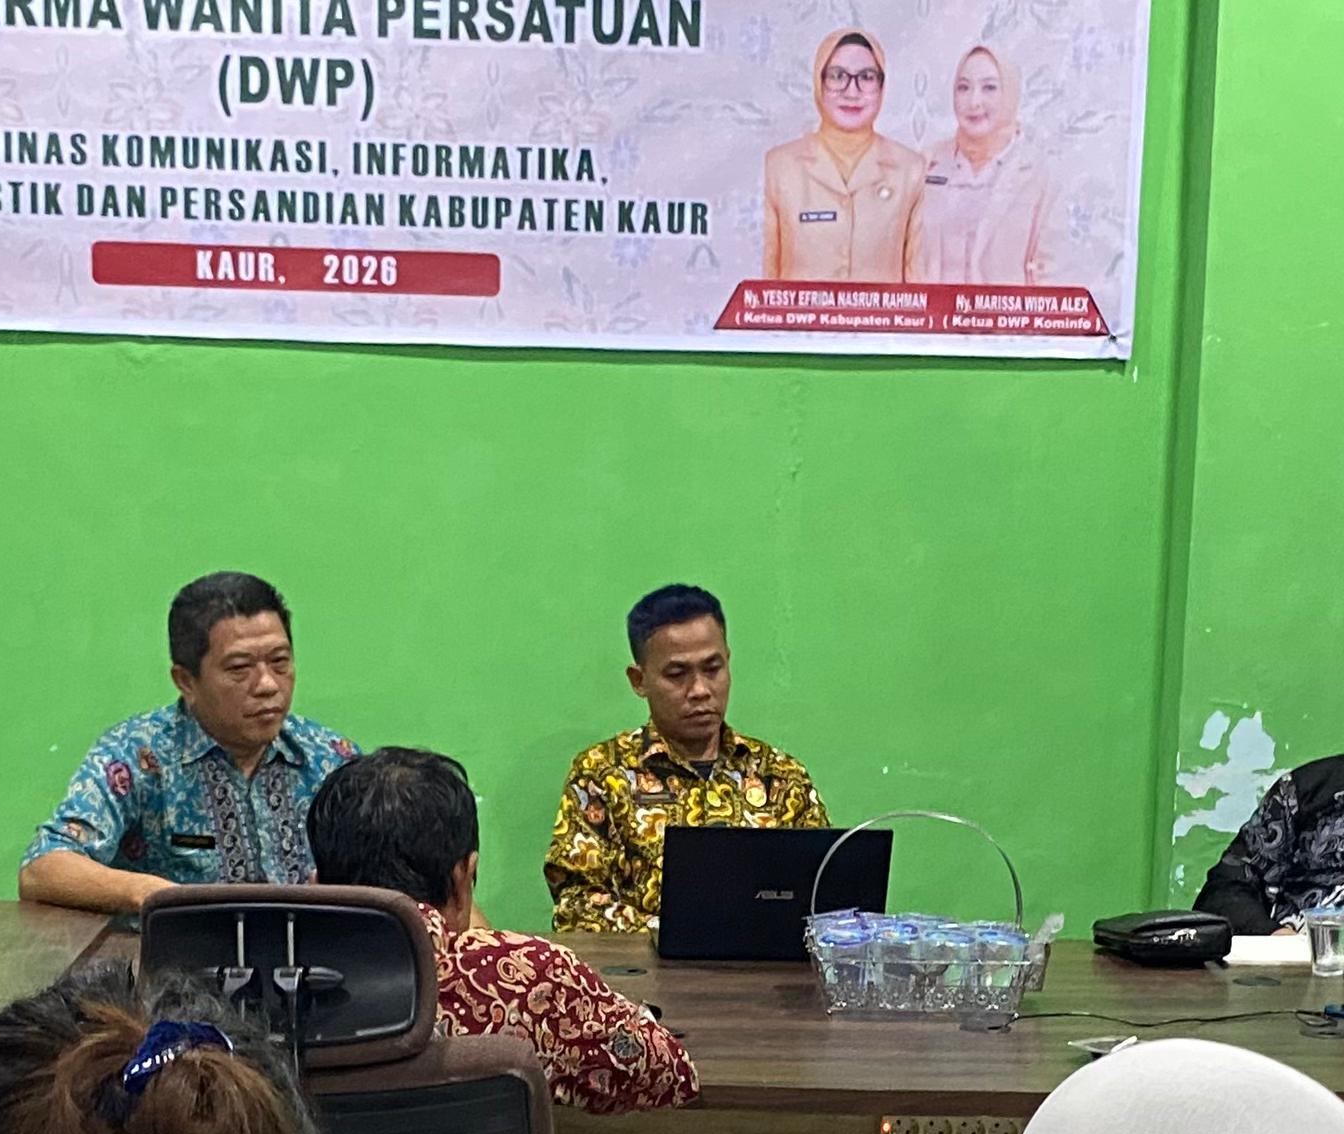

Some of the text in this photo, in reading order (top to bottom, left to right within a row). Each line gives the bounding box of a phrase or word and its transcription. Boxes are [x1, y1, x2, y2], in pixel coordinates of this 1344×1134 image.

[143, 0, 356, 37] WANITA
[378, 0, 701, 47] PERSATUAN
[219, 54, 374, 121] (DWP)
[102, 133, 339, 178] KOMUNIKASI,
[353, 142, 609, 185] INFORMATIKA,
[77, 184, 146, 218] DAN
[161, 186, 385, 226] PERSANDIAN
[398, 194, 604, 233] KABUPATEN
[617, 200, 709, 235] KAUR
[195, 250, 399, 286] KAUR, 2026
[762, 290, 796, 306] YESSY
[882, 292, 927, 309] RAHMAN
[975, 295, 1022, 311] MARISSA
[1024, 295, 1058, 312] WIDYA
[1061, 296, 1088, 312] ALEX
[744, 312, 783, 324] Ketua
[786, 313, 816, 324] DWP
[820, 313, 891, 327] Kabupaten
[894, 315, 926, 326] Kaur
[952, 315, 993, 328] Ketua
[998, 316, 1030, 328] DWP
[1034, 317, 1091, 329] Kominfo
